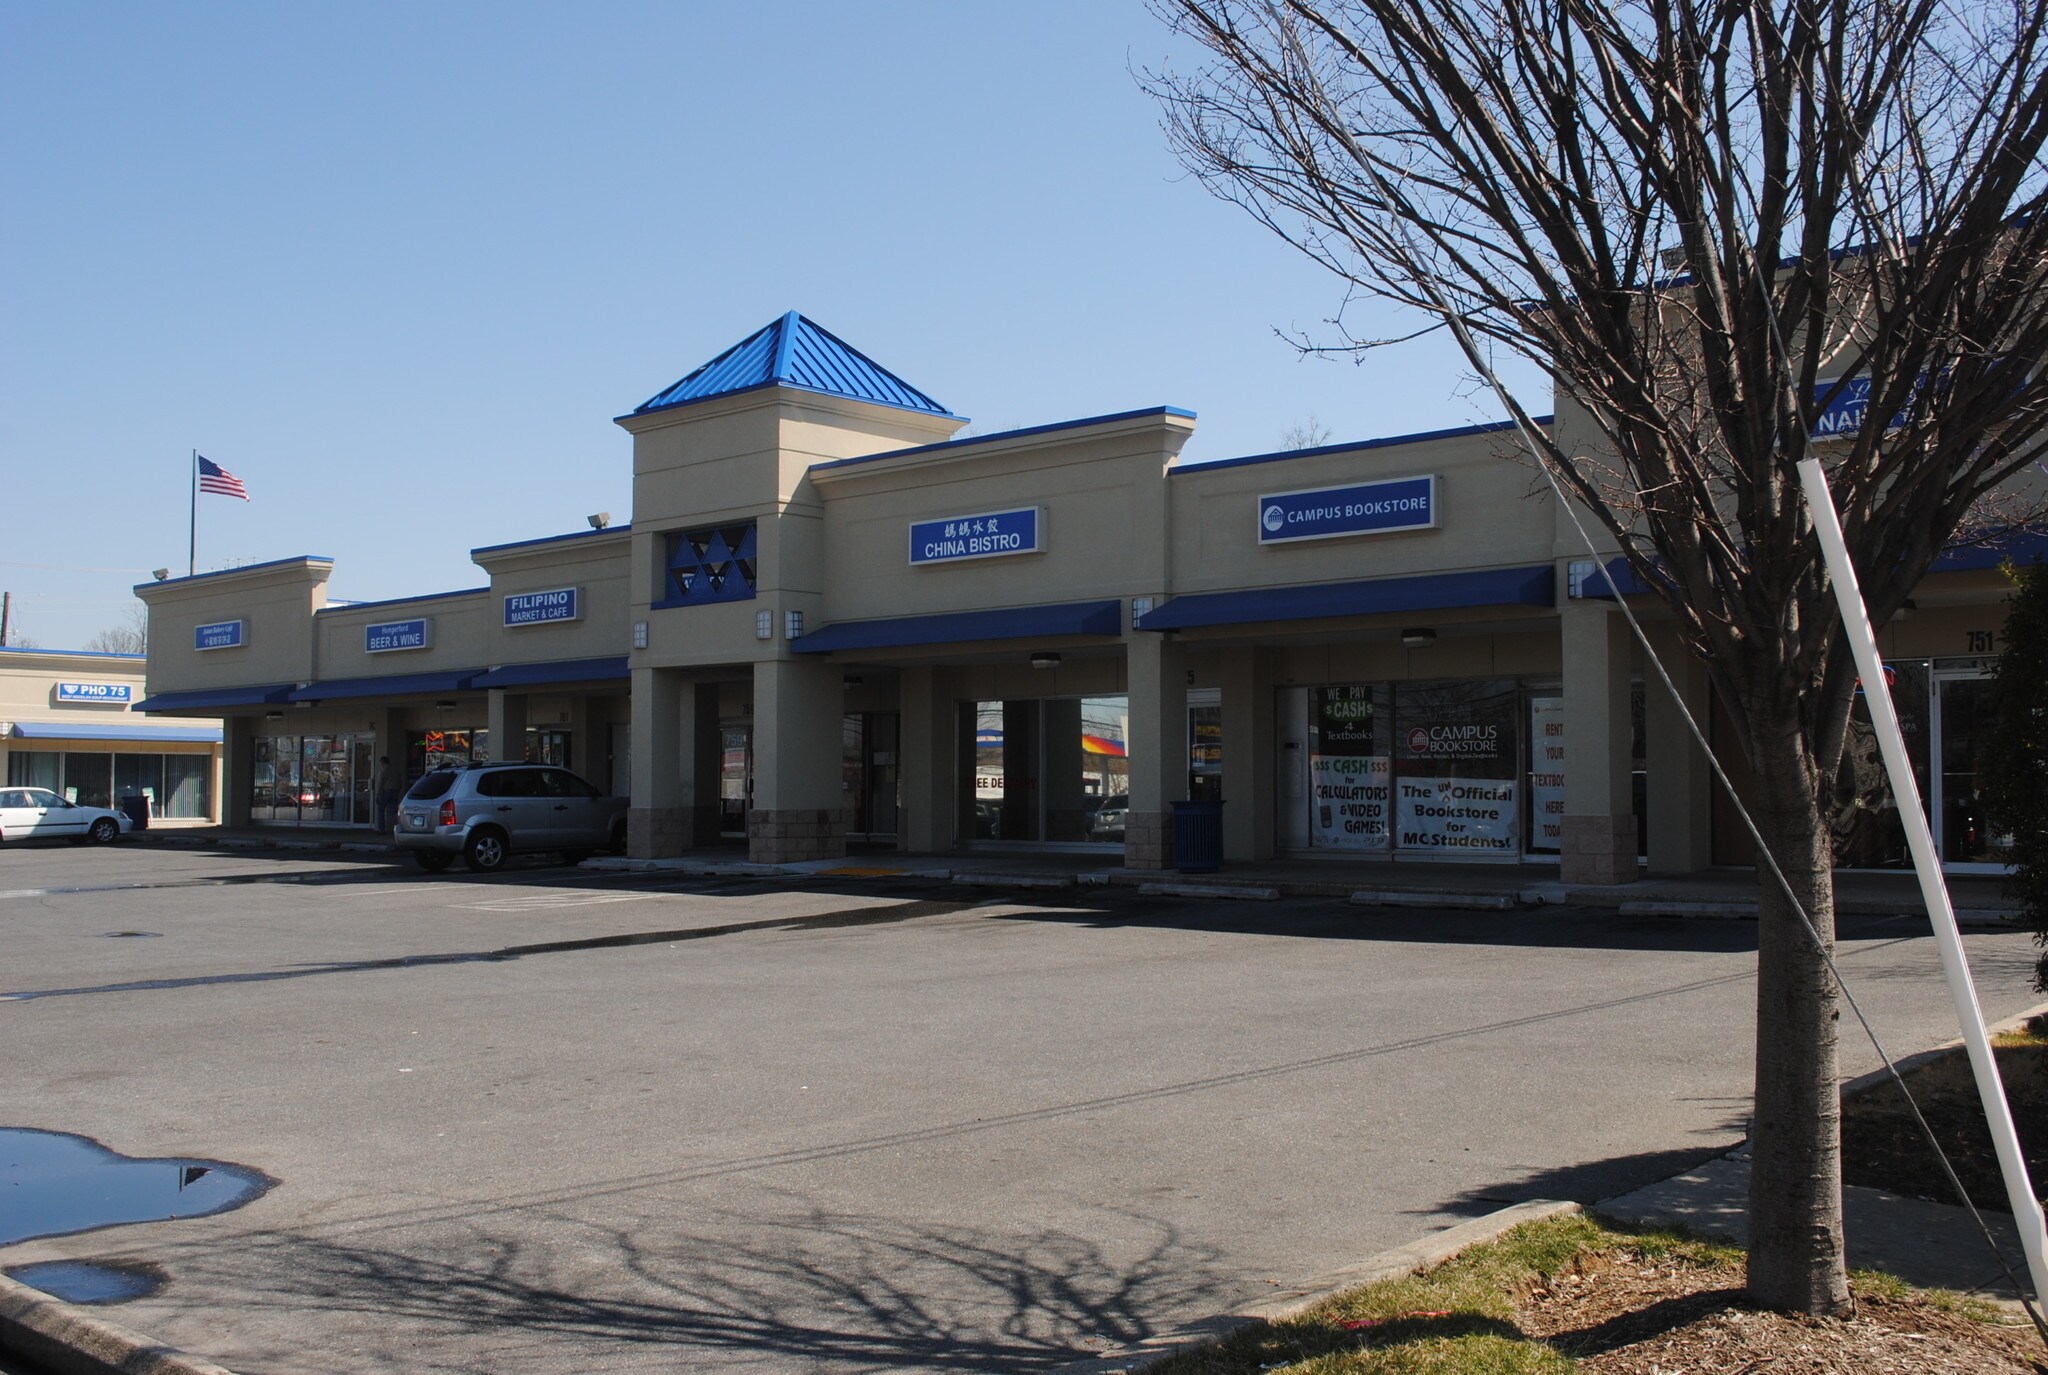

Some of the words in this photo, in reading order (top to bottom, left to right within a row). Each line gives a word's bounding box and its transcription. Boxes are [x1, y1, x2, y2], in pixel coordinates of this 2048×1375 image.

[1287, 506, 1341, 523] CAMPUS
[1345, 497, 1427, 517] BOOKSTORE
[925, 540, 966, 558] CHINA
[970, 532, 1020, 553] BISTRO
[511, 592, 568, 610] FILIPINO
[511, 610, 540, 622] MARKET
[541, 609, 547, 618] &
[548, 606, 567, 618] CAFE
[381, 624, 409, 635] Hungerford
[370, 636, 391, 648] BEER
[392, 635, 398, 646] &
[400, 633, 420, 646] WINE
[1966, 631, 1993, 651] 751
[81, 686, 107, 695] PHO
[110, 687, 126, 696] 75
[1327, 687, 1340, 700] WE
[1350, 686, 1366, 699] PAY
[1344, 722, 1354, 730] 4
[1430, 725, 1497, 740] CAMPUS
[1545, 723, 1564, 737] RENT
[726, 734, 743, 746] 759
[1326, 730, 1373, 740] Textbooks
[1430, 740, 1497, 752] BOOKSTORE
[1546, 747, 1565, 760] YOUR
[1315, 760, 1330, 771] $$$
[1333, 759, 1368, 775] CASH
[1371, 761, 1388, 772] $$$
[1345, 776, 1355, 784] for
[1316, 785, 1388, 801] CALCULATORS
[1401, 785, 1431, 798] The
[1437, 781, 1451, 793] UN
[1451, 786, 1512, 801] Official
[1340, 805, 1346, 815] &
[1347, 804, 1381, 817] VIDEO
[1414, 804, 1499, 819] Bookstore
[1545, 801, 1564, 814] HERE
[1345, 820, 1384, 834] GAMES!
[1446, 822, 1466, 832] for
[1543, 824, 1560, 837] TODA
[1403, 832, 1429, 845] MC
[1431, 833, 1511, 847] Students!
